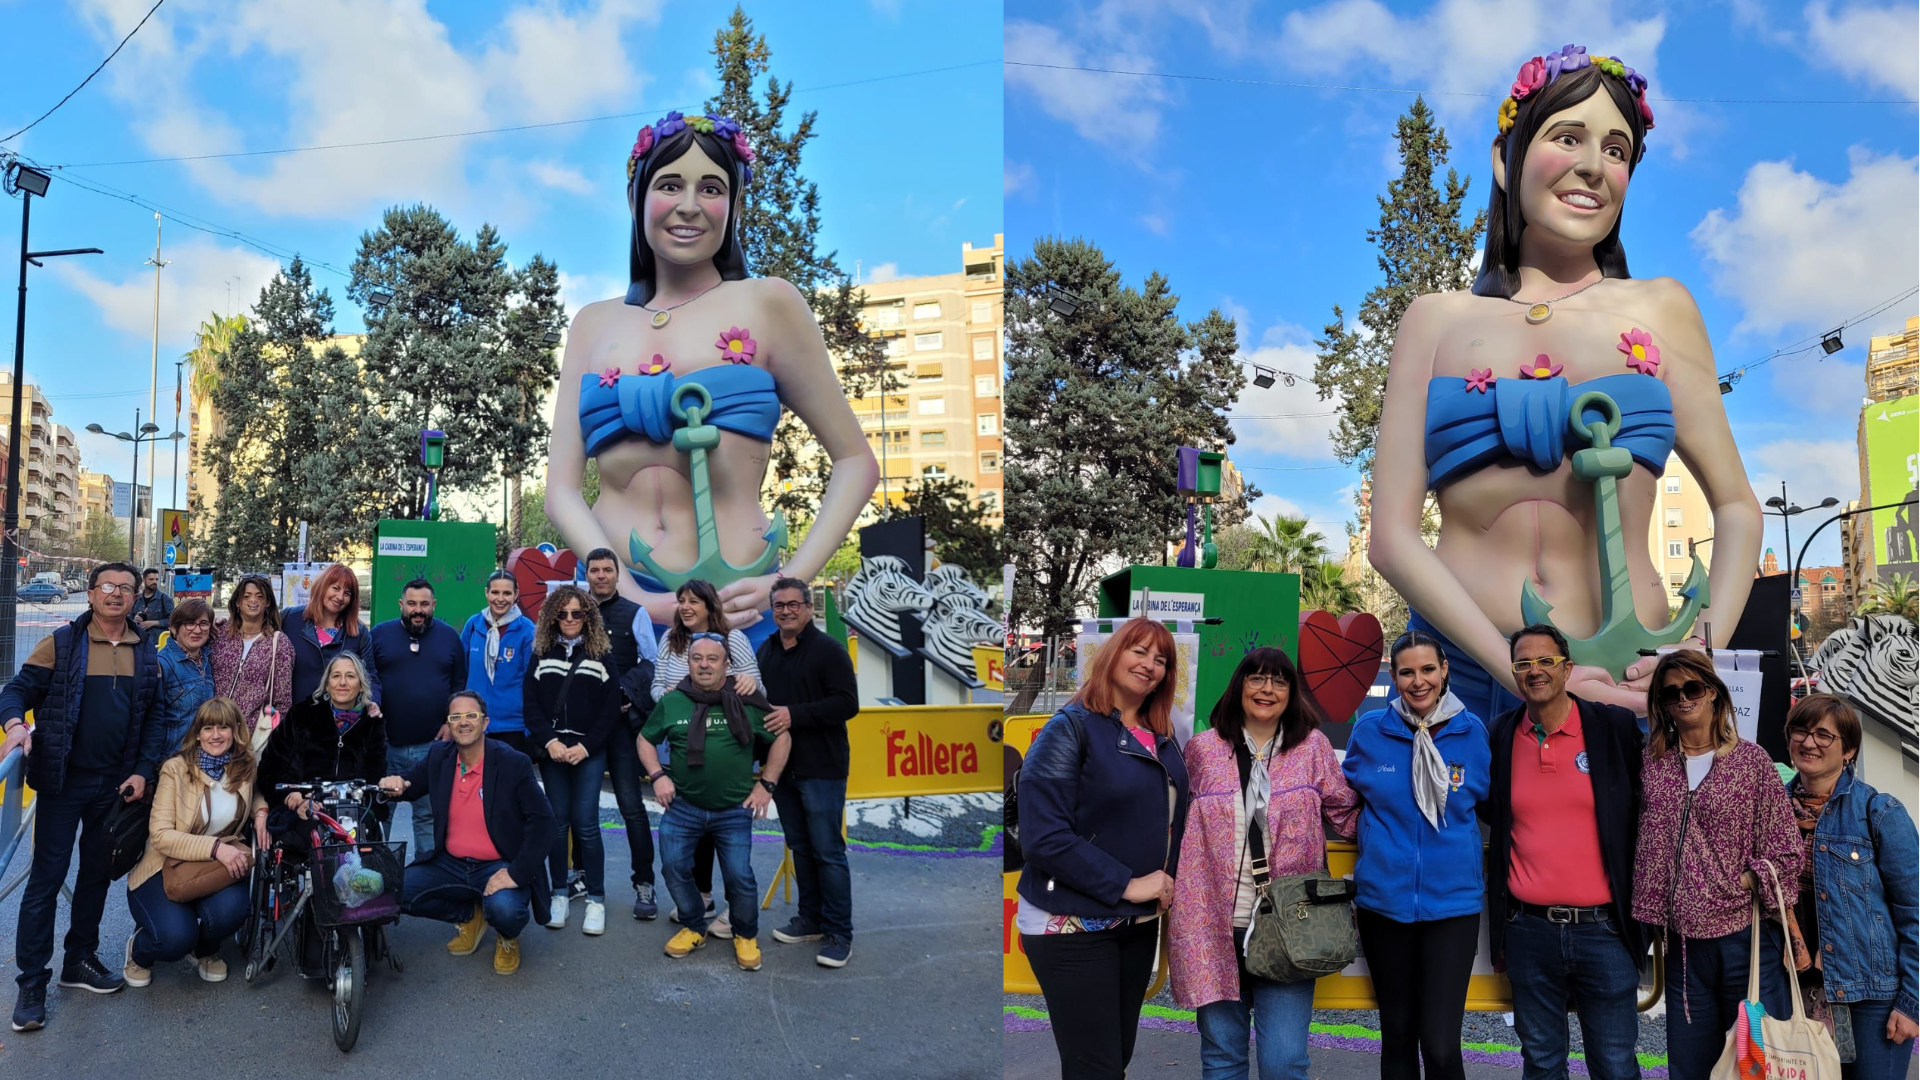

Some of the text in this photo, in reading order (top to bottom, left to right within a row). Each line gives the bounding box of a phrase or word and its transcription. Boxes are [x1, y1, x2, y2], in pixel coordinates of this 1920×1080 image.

[379, 543, 384, 551] LA
[385, 543, 398, 551] CABINA
[1132, 599, 1140, 611] LA
[1140, 600, 1160, 611] CBINA
[1160, 600, 1168, 612] DE
[1728, 685, 1744, 693] LLAS
[1733, 706, 1751, 717] PAZ
[887, 729, 979, 778] Fallera
[1777, 1065, 1807, 1080] VIDA
